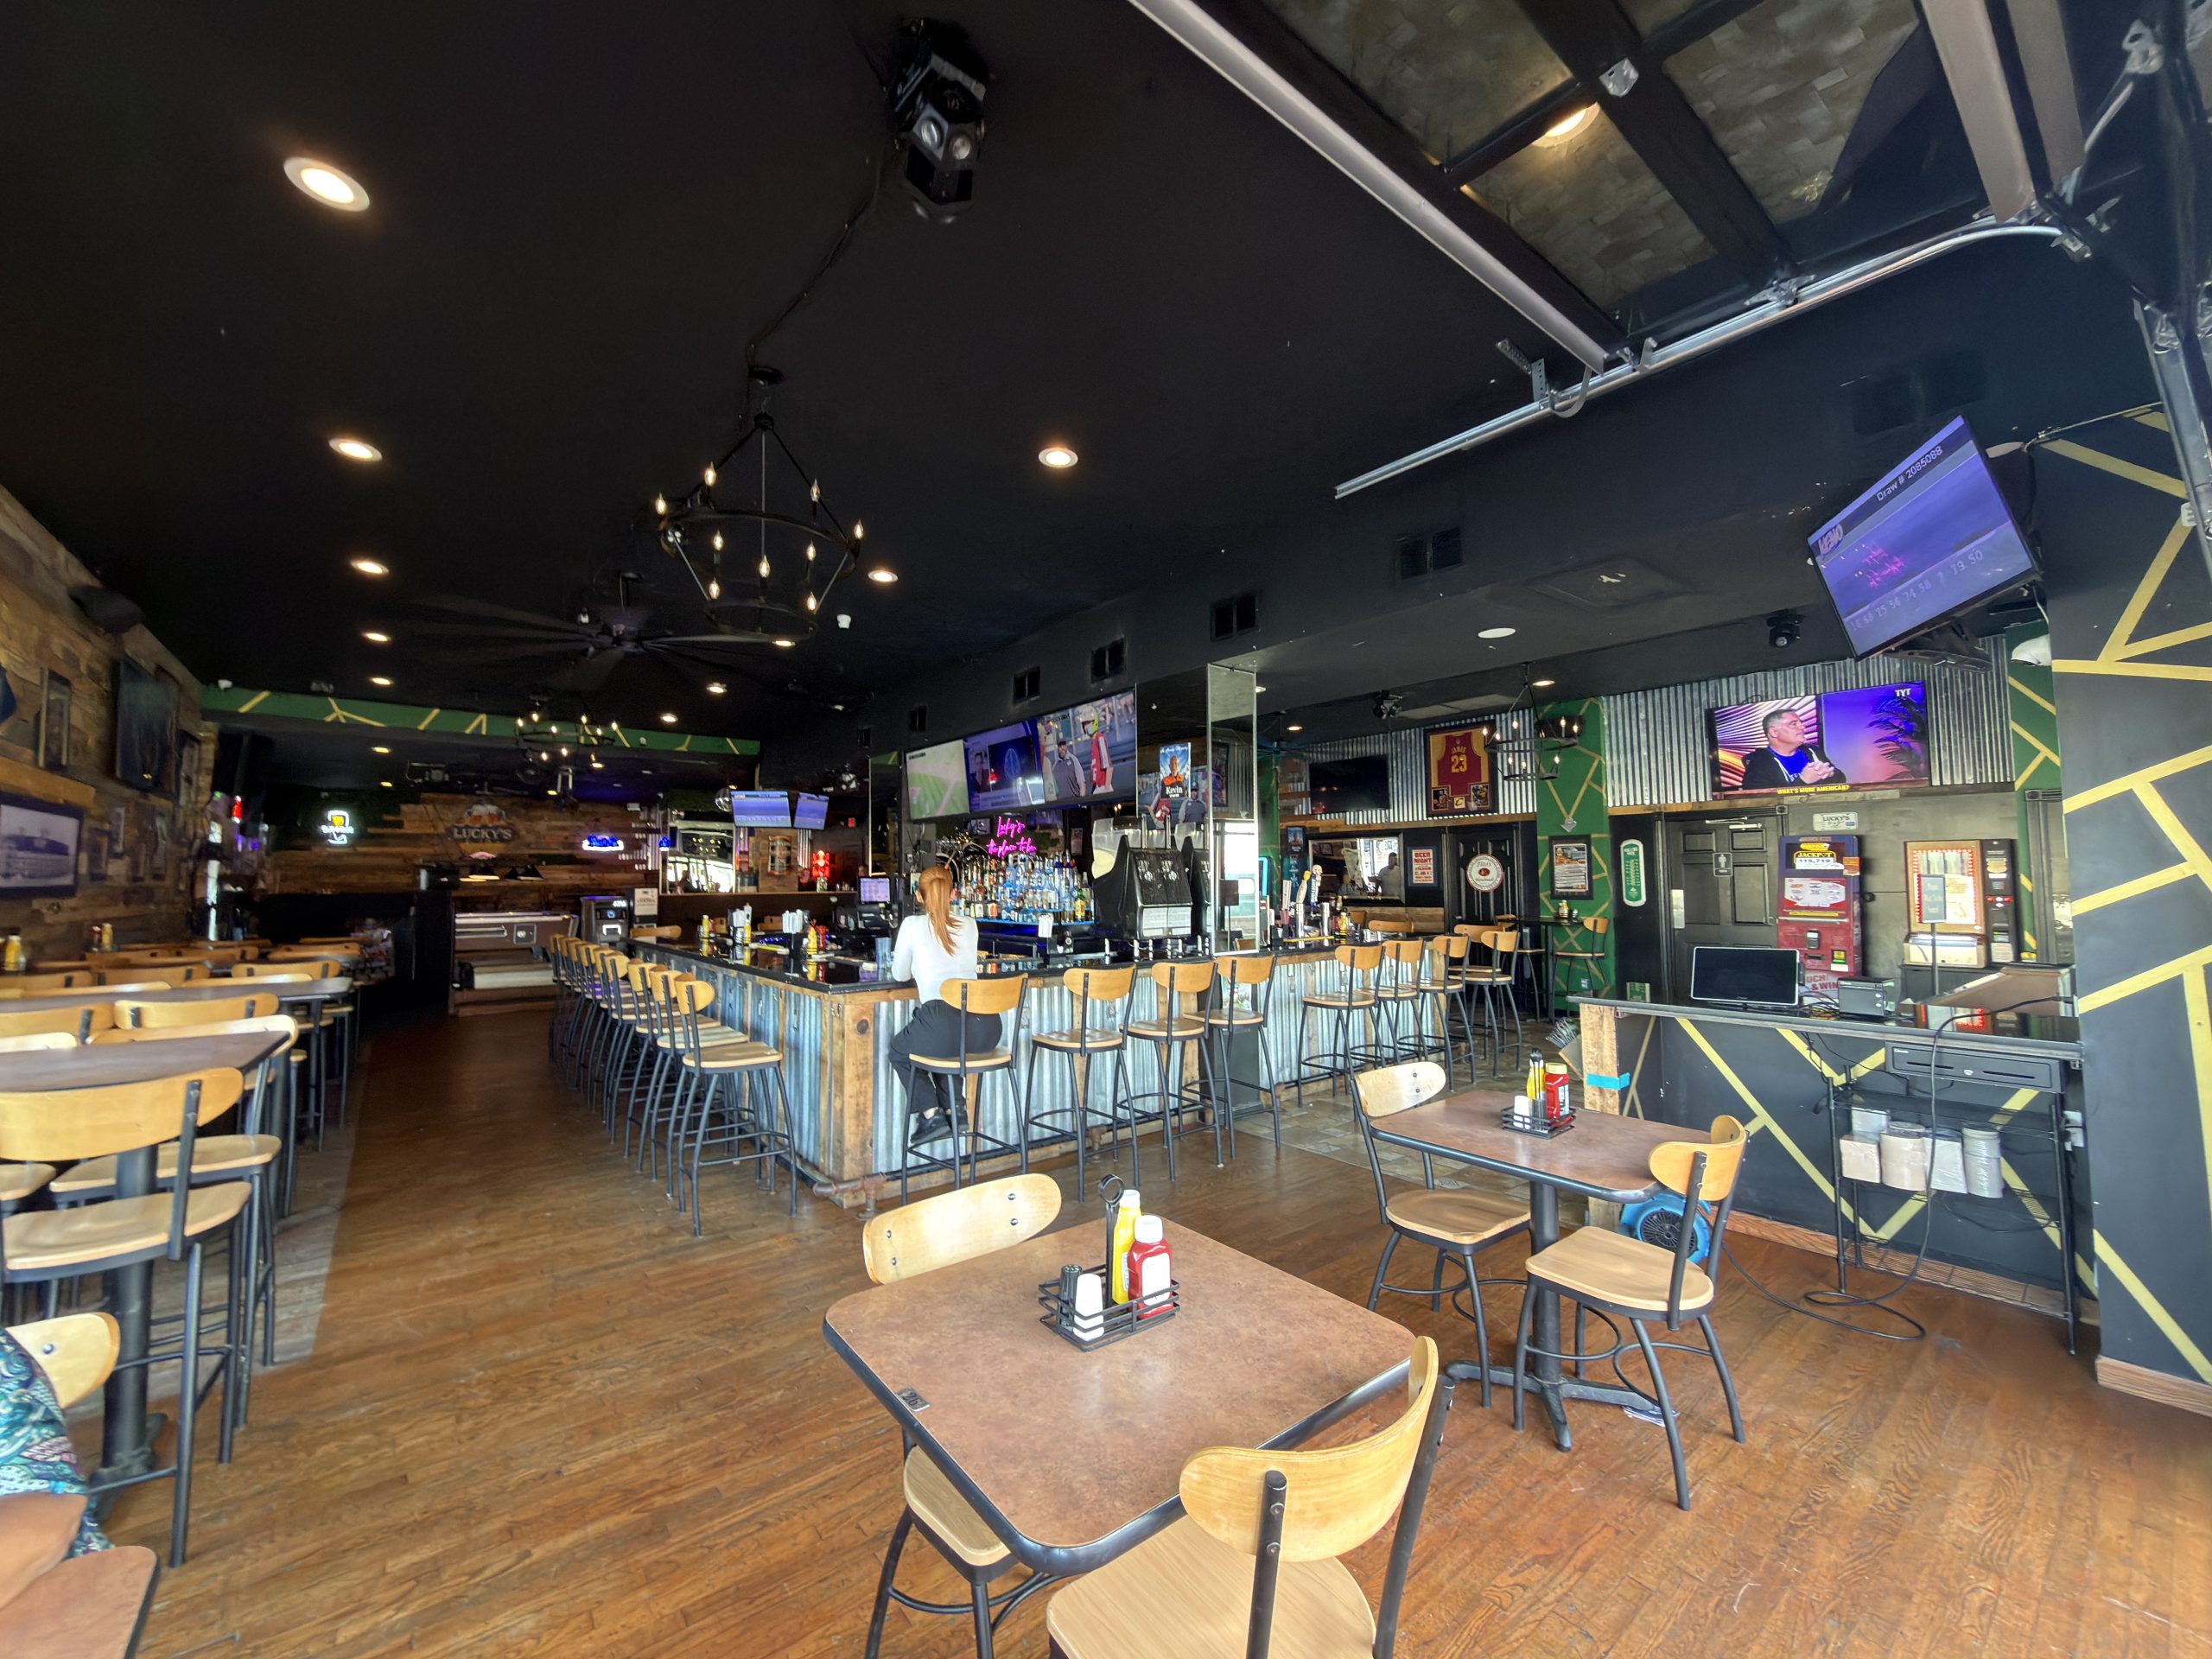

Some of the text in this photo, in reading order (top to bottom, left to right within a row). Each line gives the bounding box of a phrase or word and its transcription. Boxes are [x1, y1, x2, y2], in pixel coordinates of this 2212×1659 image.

[1877, 481, 1898, 501] Draw
[1894, 688, 1911, 696] TYT
[1451, 754, 1468, 773] 23
[1166, 785, 1183, 794] Kevin
[996, 816, 1026, 838] Lucky's
[453, 828, 512, 840] LUCKY'S
[1806, 974, 1826, 983] UCH
